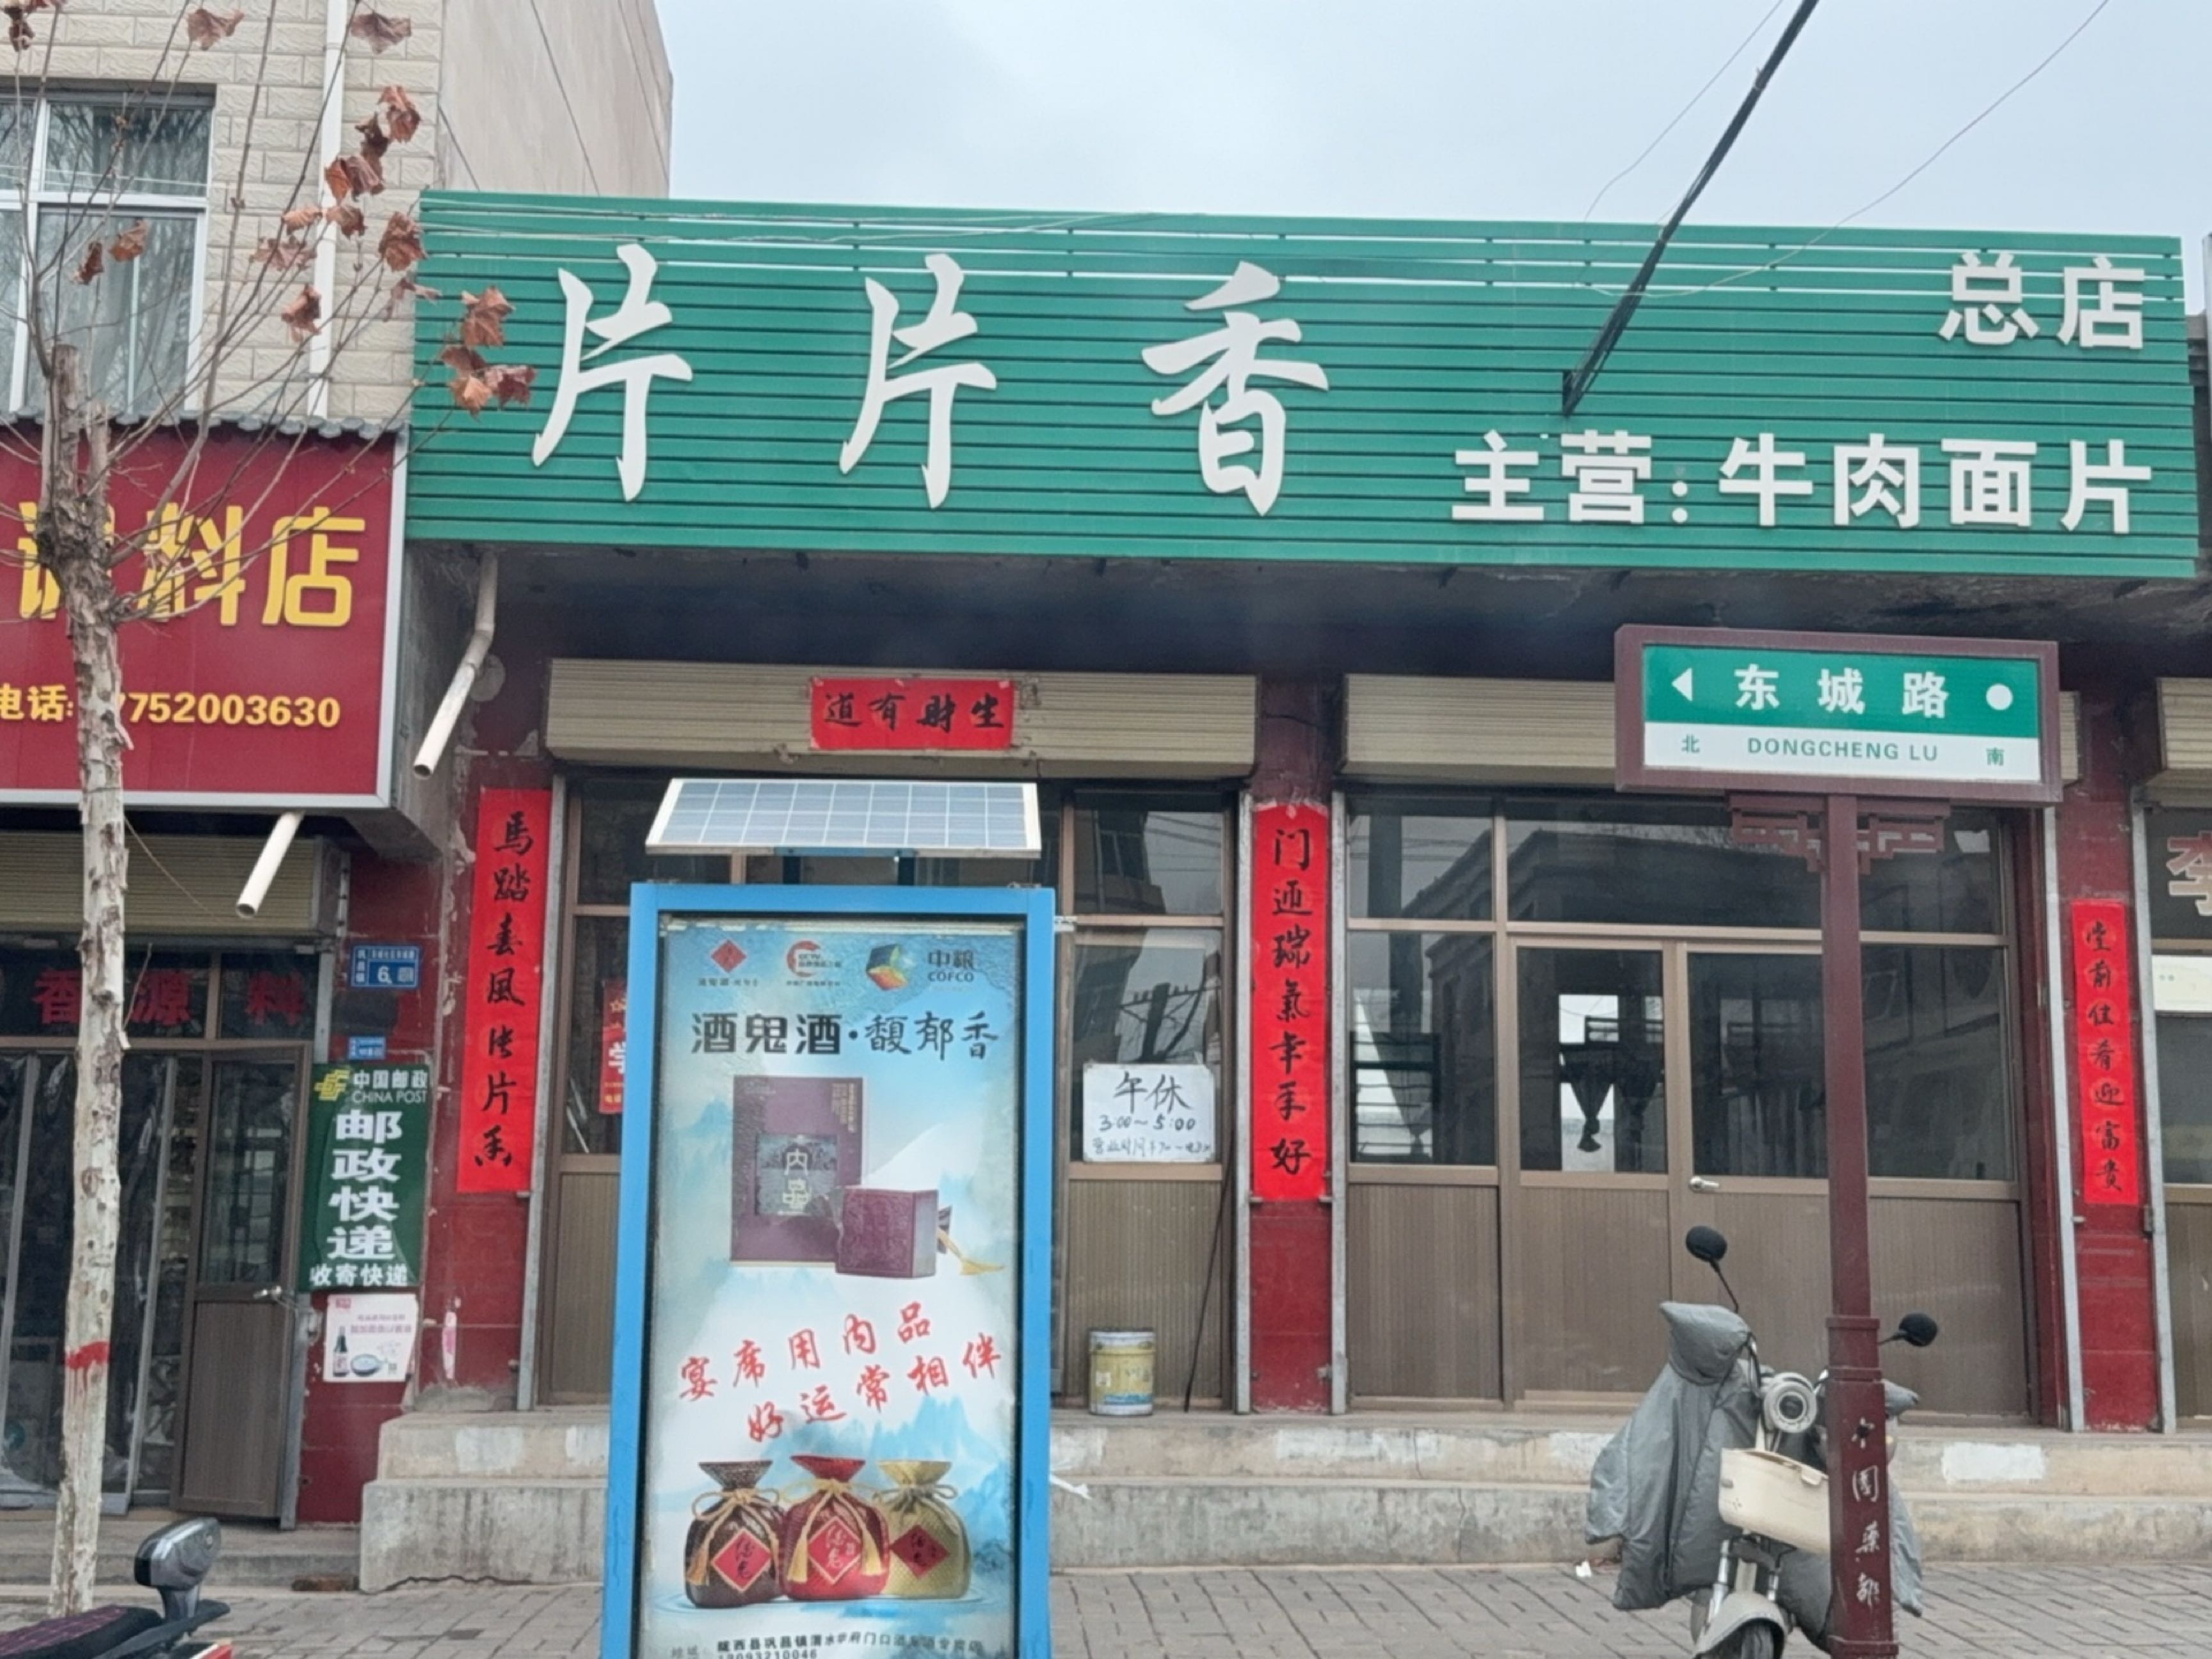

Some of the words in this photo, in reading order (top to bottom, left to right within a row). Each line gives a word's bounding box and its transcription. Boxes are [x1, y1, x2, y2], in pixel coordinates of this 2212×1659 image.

[1938, 252, 2145, 349] 总店
[533, 243, 1329, 517] 片片香
[1734, 664, 1949, 718] 东城路
[1681, 734, 1699, 753] 北
[1747, 738, 1898, 760] DONGCHENG
[1909, 743, 1937, 762] LU
[1986, 747, 2004, 766] 南
[929, 950, 974, 969] 中粮
[929, 971, 974, 982] COFCO
[353, 1070, 428, 1089] 中国邮政
[353, 1090, 393, 1103] CHINA
[396, 1090, 426, 1103] POST
[1113, 1070, 1193, 1114] 午休
[326, 1109, 403, 1260] 邮政快递
[309, 1263, 408, 1286] 收寄快递
[747, 1332, 1001, 1442] 好运常相伴
